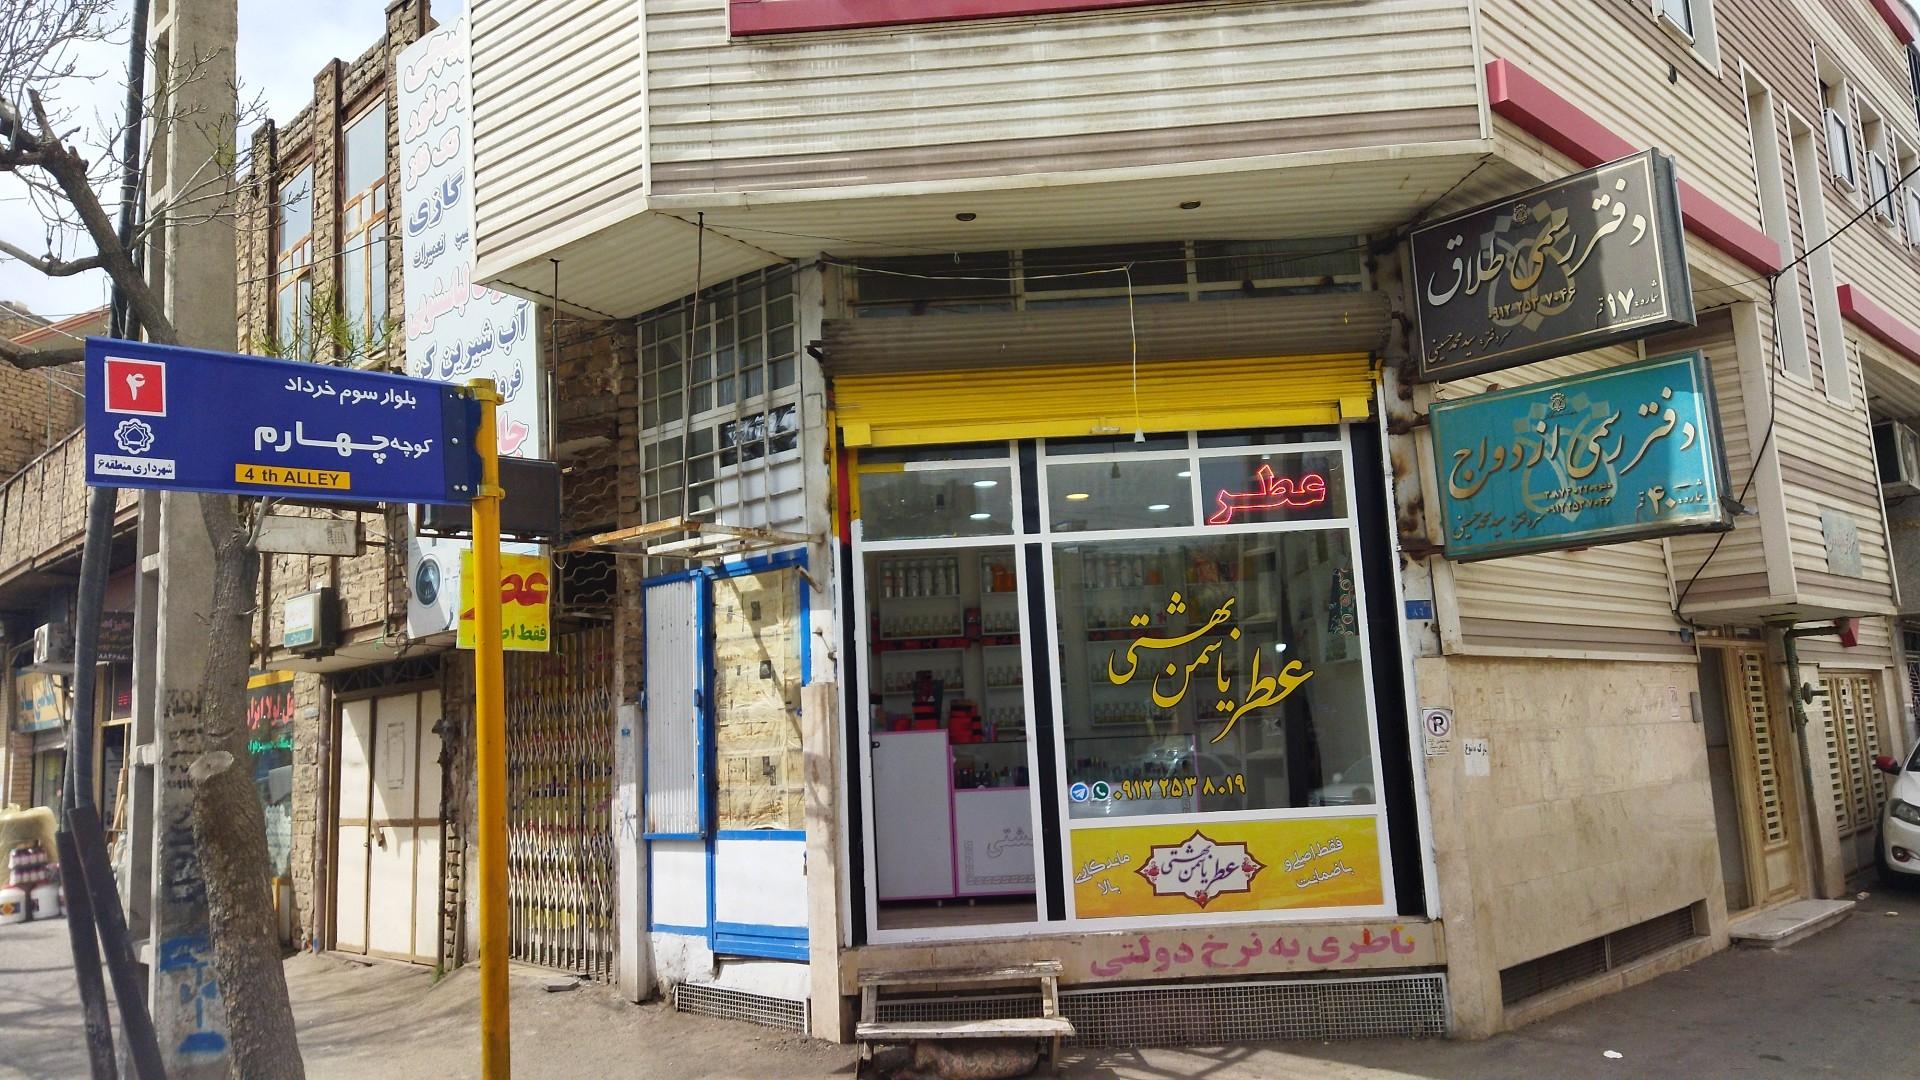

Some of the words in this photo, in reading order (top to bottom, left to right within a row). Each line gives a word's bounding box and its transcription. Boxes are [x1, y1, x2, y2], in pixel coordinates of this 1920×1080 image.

[407, 170, 465, 236] گازی
[1567, 179, 1647, 278] دفتر
[1427, 234, 1506, 306] طلاق
[1509, 216, 1577, 290] رسمی
[1607, 287, 1635, 318] ۱۷
[499, 301, 530, 351] آب
[440, 320, 495, 380] شیرین
[125, 372, 146, 402] ۴
[284, 376, 337, 398] خرداد
[339, 388, 379, 406] سوم
[380, 386, 417, 410] بلوار
[254, 420, 391, 465] چهارم
[1566, 410, 1624, 480] رسمی
[1619, 386, 1696, 475] دفتر
[389, 437, 434, 460] کوچه
[1449, 420, 1561, 499] ازدواج
[132, 462, 172, 477] شهرداری
[244, 468, 255, 481] 4
[262, 469, 279, 482] th
[284, 470, 340, 486] ALLEY
[1208, 464, 1326, 524] عطر
[518, 624, 547, 643] فقط
[1108, 591, 1236, 685] بهشتی
[1151, 627, 1241, 712] یاسمن
[1210, 648, 1314, 744] عطر
[1112, 778, 1154, 800] ۰۹۱۲
[1157, 776, 1197, 798] ۲۵۳
[1202, 773, 1247, 795] ۸۰۱۹
[1160, 844, 1212, 875] بهشتی
[1293, 845, 1317, 871] اصلی
[1316, 836, 1344, 857] فقط
[1074, 849, 1131, 885] ماندگاری
[1178, 853, 1213, 884] یاسمن
[1204, 858, 1240, 892] عطر
[1284, 858, 1293, 872] و
[1097, 878, 1121, 896] بالا
[1090, 935, 1195, 978] دولتی
[1201, 931, 1264, 969] نرخ
[1269, 936, 1300, 965] به
